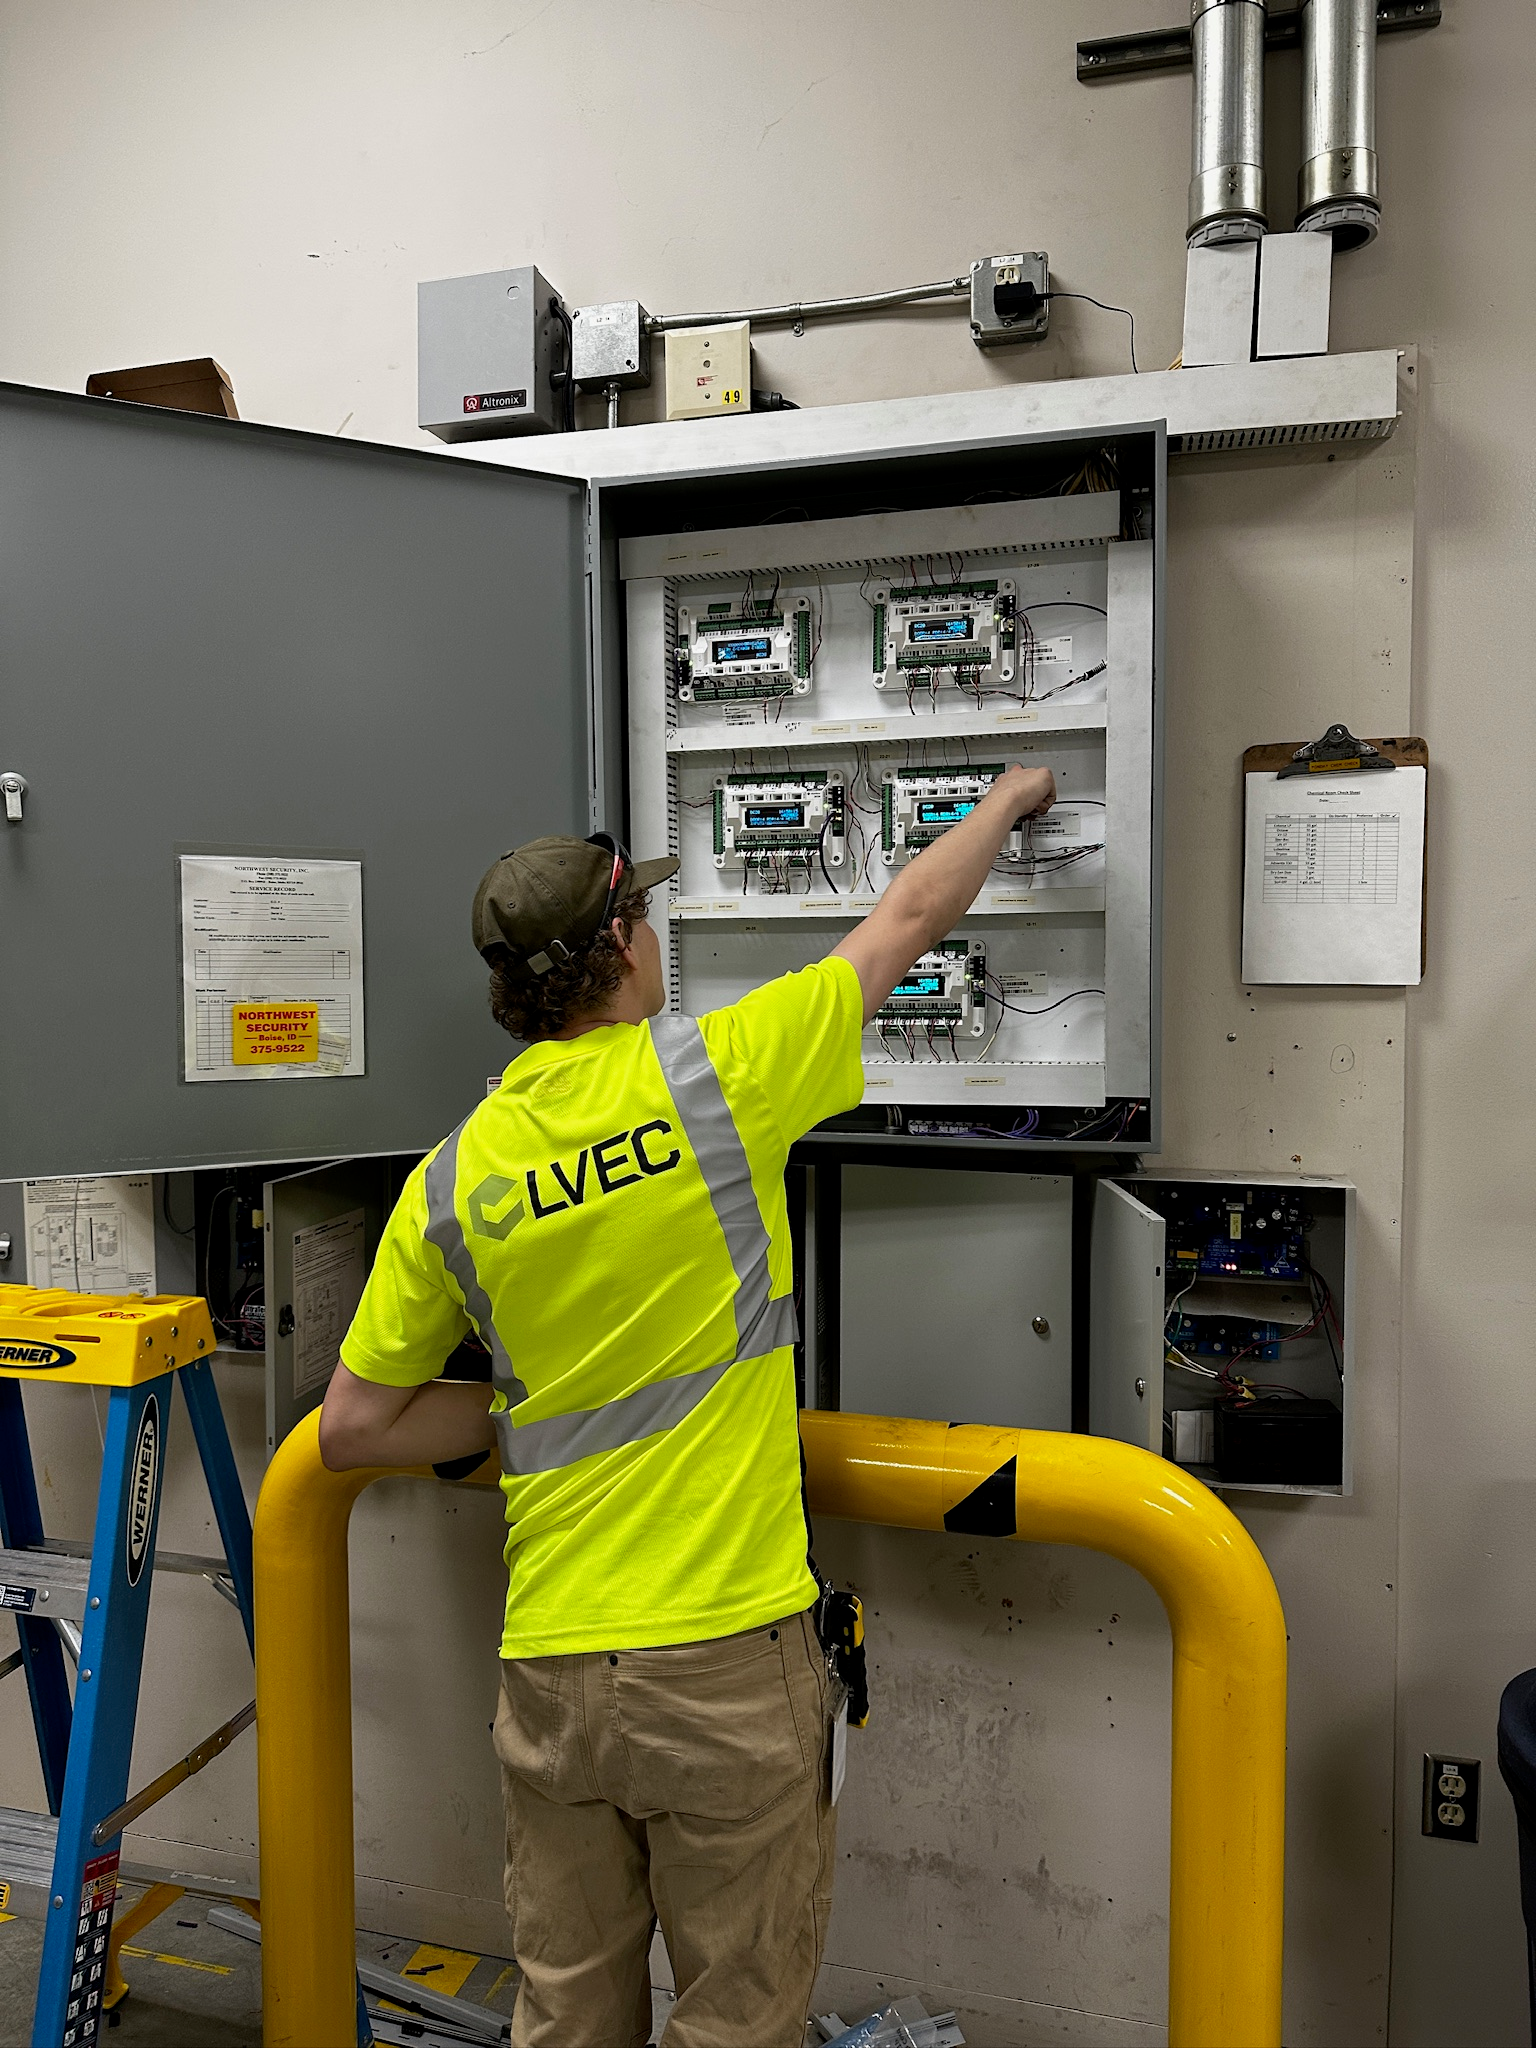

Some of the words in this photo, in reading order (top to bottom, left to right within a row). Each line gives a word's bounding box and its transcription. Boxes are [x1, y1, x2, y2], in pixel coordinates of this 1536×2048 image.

[482, 395, 519, 408] Altronix
[724, 390, 740, 403] 49
[238, 1011, 316, 1020] NORTHWEST
[246, 1022, 309, 1032] SECURITY
[250, 1045, 305, 1054] 375-9522
[526, 1119, 681, 1219] LVEC
[133, 1432, 153, 1545] WERNER
